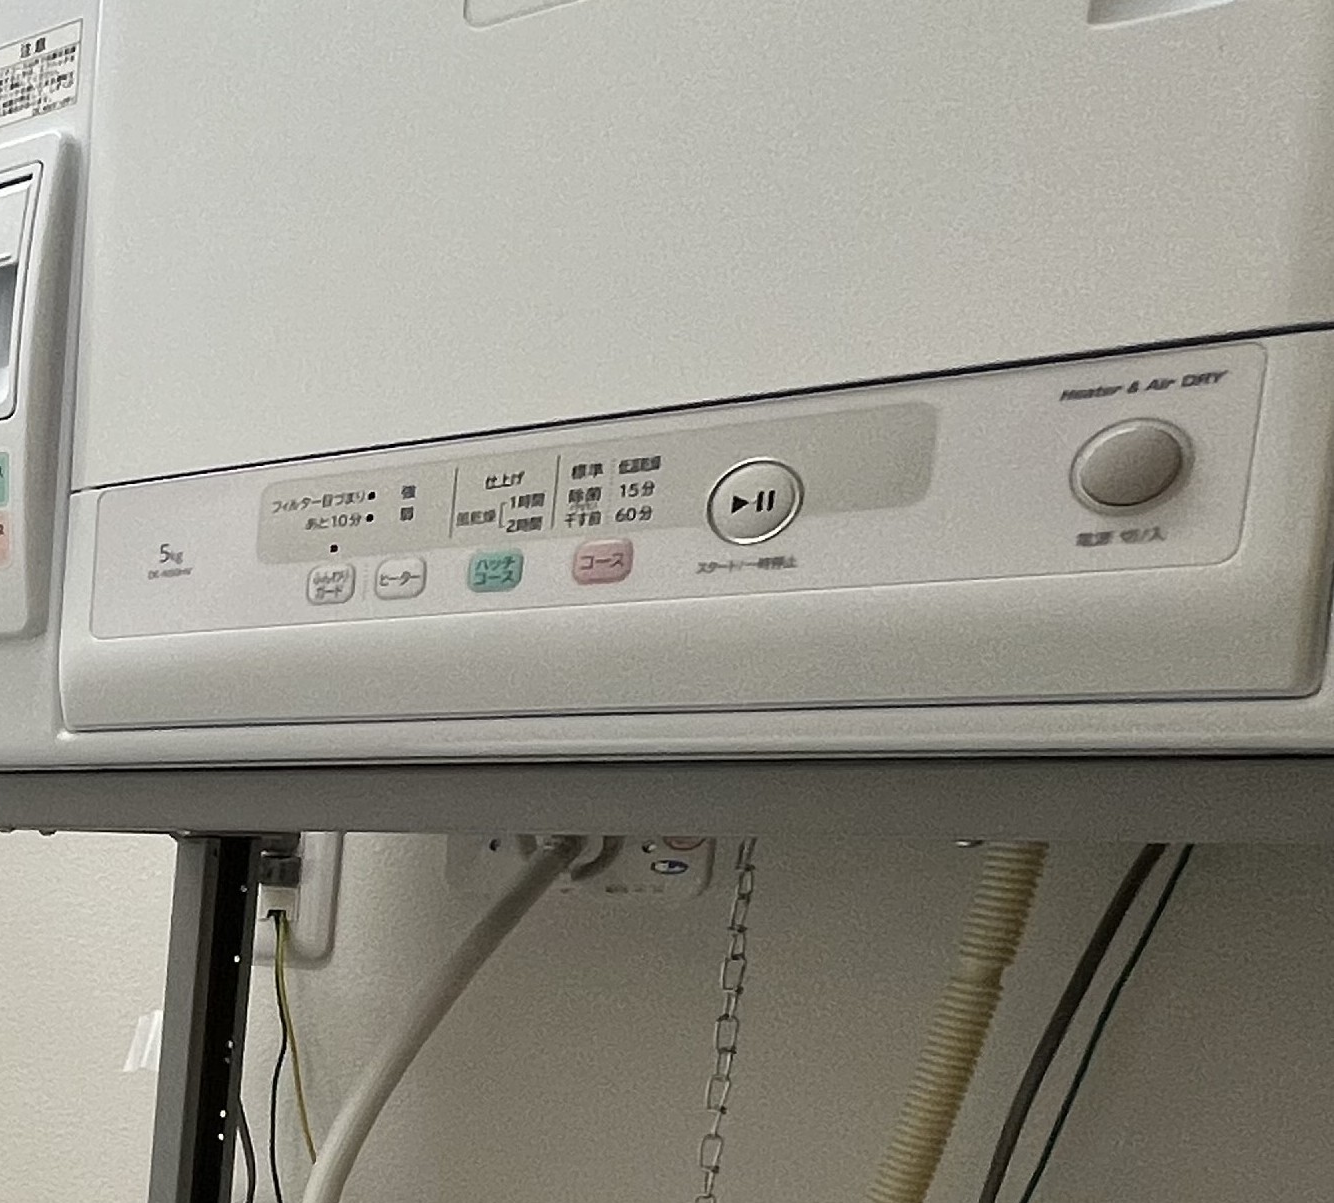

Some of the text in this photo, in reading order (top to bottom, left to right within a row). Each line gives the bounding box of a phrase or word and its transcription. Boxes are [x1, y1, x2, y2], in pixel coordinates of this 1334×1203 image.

[1145, 378, 1176, 391] Air
[1181, 370, 1228, 387] DRY
[620, 480, 655, 498] 15分
[615, 505, 653, 522] 60分
[475, 556, 516, 571] ハッチ
[581, 552, 624, 570] コース
[379, 571, 421, 587] ヒーター
[474, 570, 515, 586] コース
